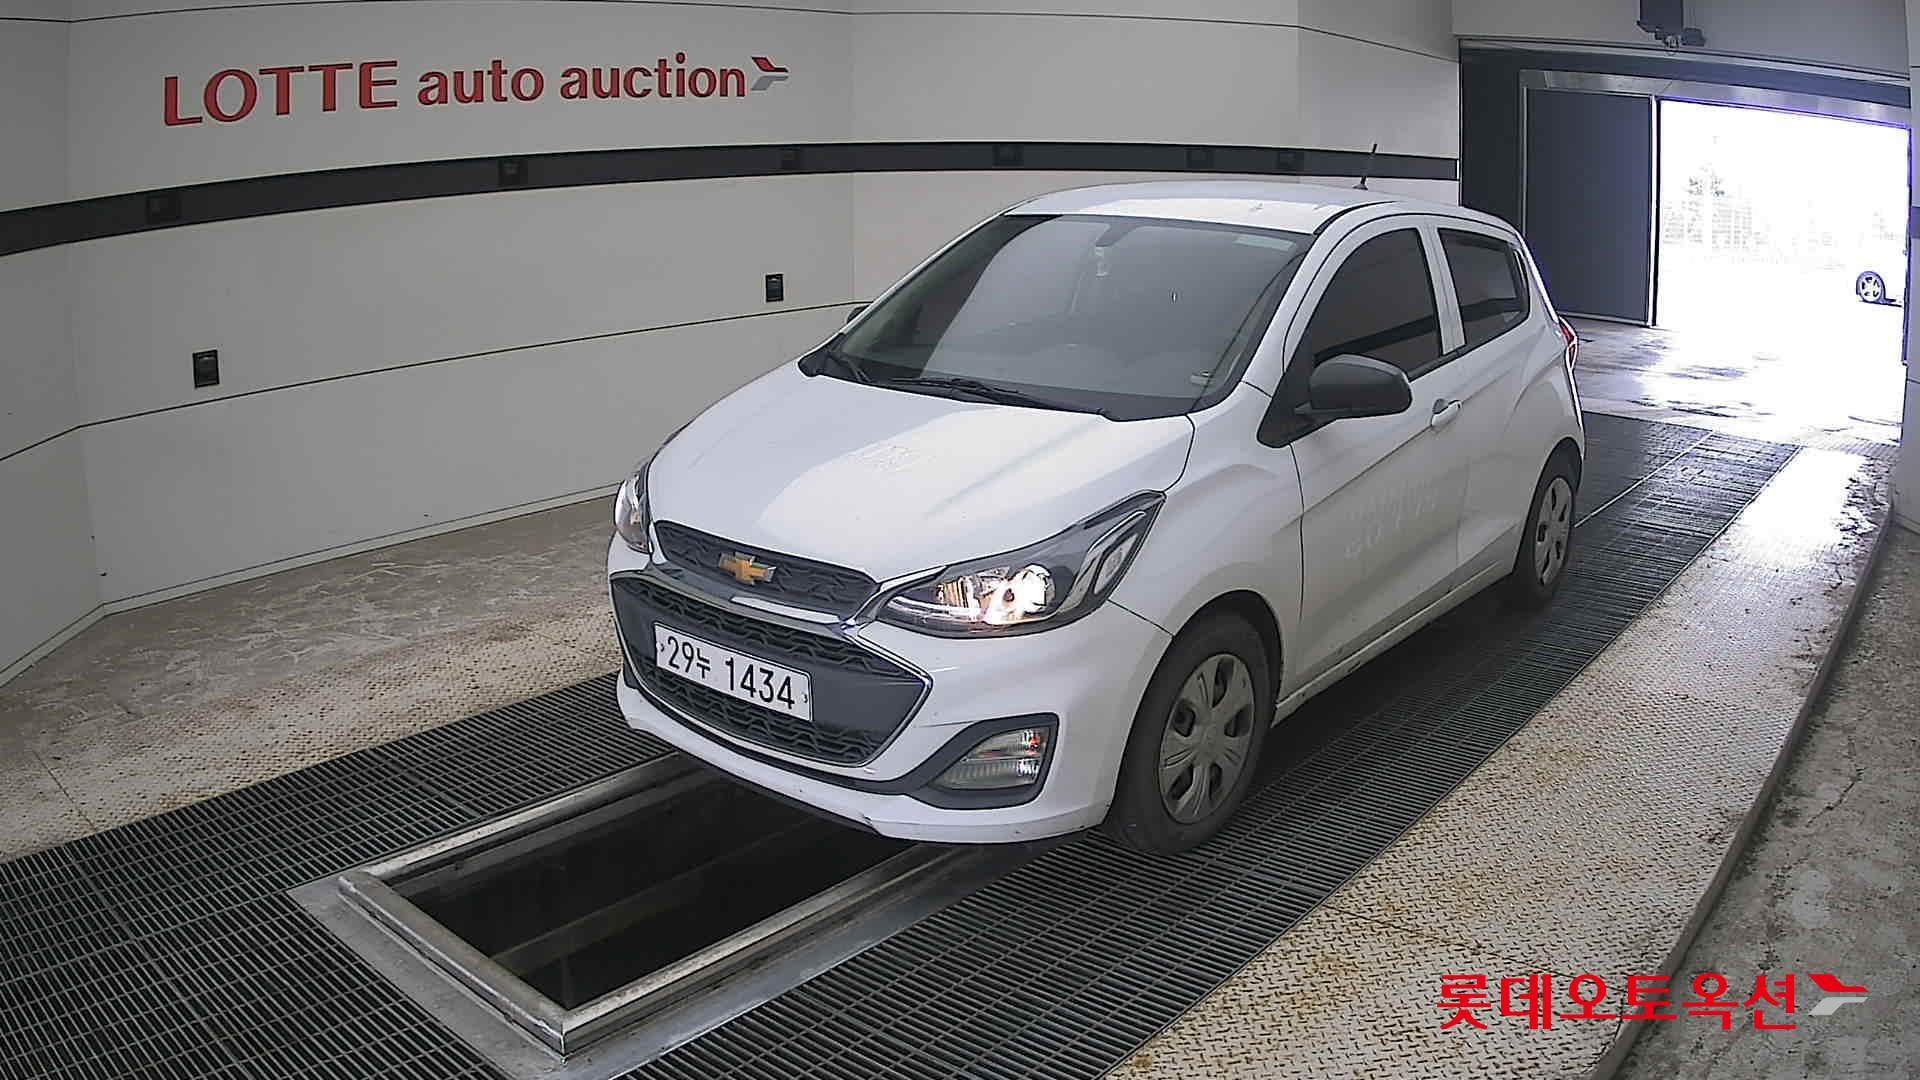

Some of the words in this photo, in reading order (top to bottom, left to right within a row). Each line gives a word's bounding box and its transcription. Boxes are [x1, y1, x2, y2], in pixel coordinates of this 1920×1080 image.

[163, 60, 399, 126] LOTTE
[417, 61, 544, 105] auto
[559, 52, 747, 98] auction
[667, 635, 711, 679] 29누
[725, 657, 795, 709] 1434
